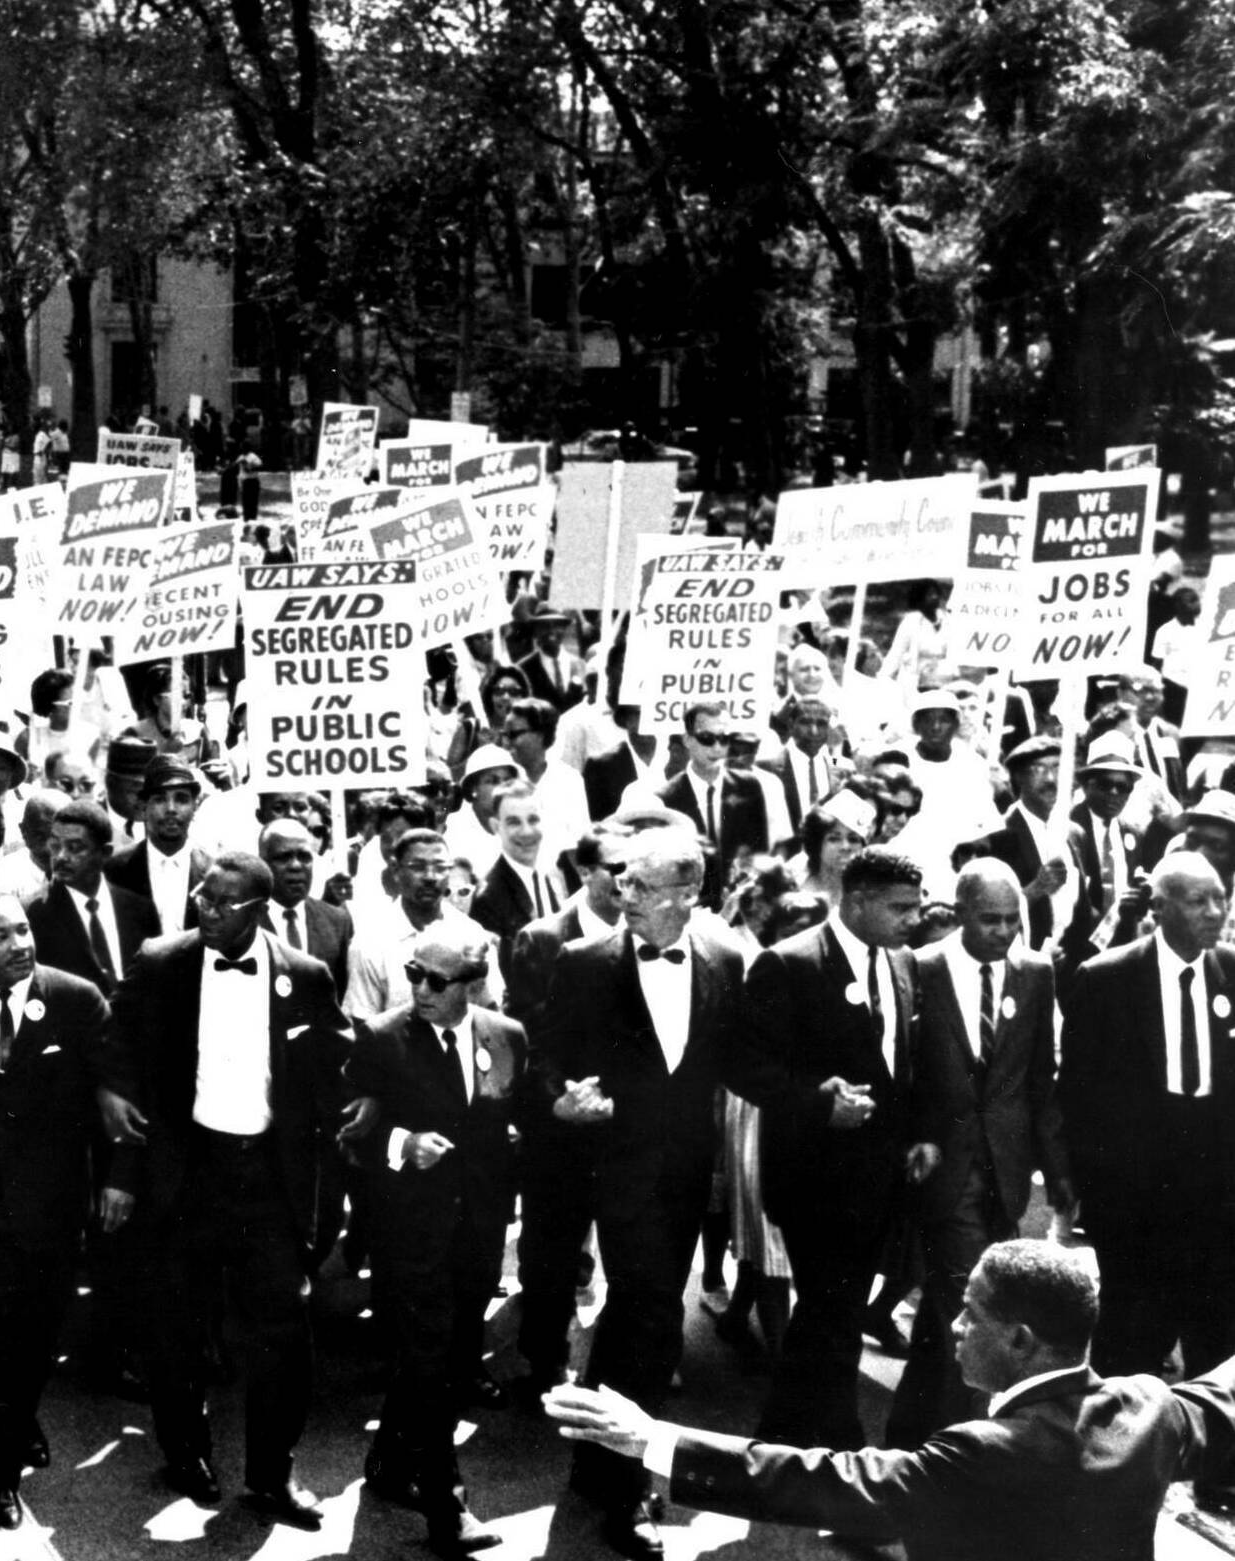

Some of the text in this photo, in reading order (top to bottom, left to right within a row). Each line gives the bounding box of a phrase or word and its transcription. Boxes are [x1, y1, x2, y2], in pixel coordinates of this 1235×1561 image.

[410, 448, 432, 460] WE
[481, 451, 514, 474] WE
[390, 460, 450, 478] MARCH
[98, 479, 138, 506] WE
[408, 478, 432, 487] FOR
[495, 503, 538, 518] FEPC
[1077, 492, 1111, 514] WE
[67, 498, 160, 538] DEMAND
[400, 511, 433, 532] WE
[1042, 512, 1139, 544] MARCH
[383, 517, 465, 558] MARCH
[489, 524, 524, 537] AW
[322, 539, 364, 552] AN FE
[489, 540, 535, 560] W!
[1071, 543, 1108, 557] FOR
[63, 546, 152, 569] AN FEPC
[153, 542, 232, 583] MAND
[421, 551, 481, 582] GRATED
[78, 573, 130, 592] LAW
[251, 562, 413, 587] UAW SAYS:
[146, 584, 223, 607] ECENT
[419, 574, 489, 608] HOOLS
[674, 578, 755, 598] END
[1038, 569, 1130, 604] JOBS
[58, 597, 137, 622] NOW!
[142, 603, 230, 628] OUSING
[273, 593, 384, 623] END
[421, 594, 489, 638] OW!
[653, 602, 773, 625] SEGREGATED
[1039, 607, 1123, 624] FOR ALL
[133, 619, 225, 653] NOW!
[251, 622, 413, 656] SEGREGATED
[669, 628, 752, 649] RULES
[1032, 625, 1131, 665] NOW!
[275, 655, 389, 686] RULES
[693, 658, 722, 669] IN
[661, 672, 756, 694] PUBLIC
[311, 694, 353, 710] IN
[653, 699, 757, 723] SCLS
[271, 711, 401, 743] PUBLIC
[266, 745, 408, 778] SCHOOLS
